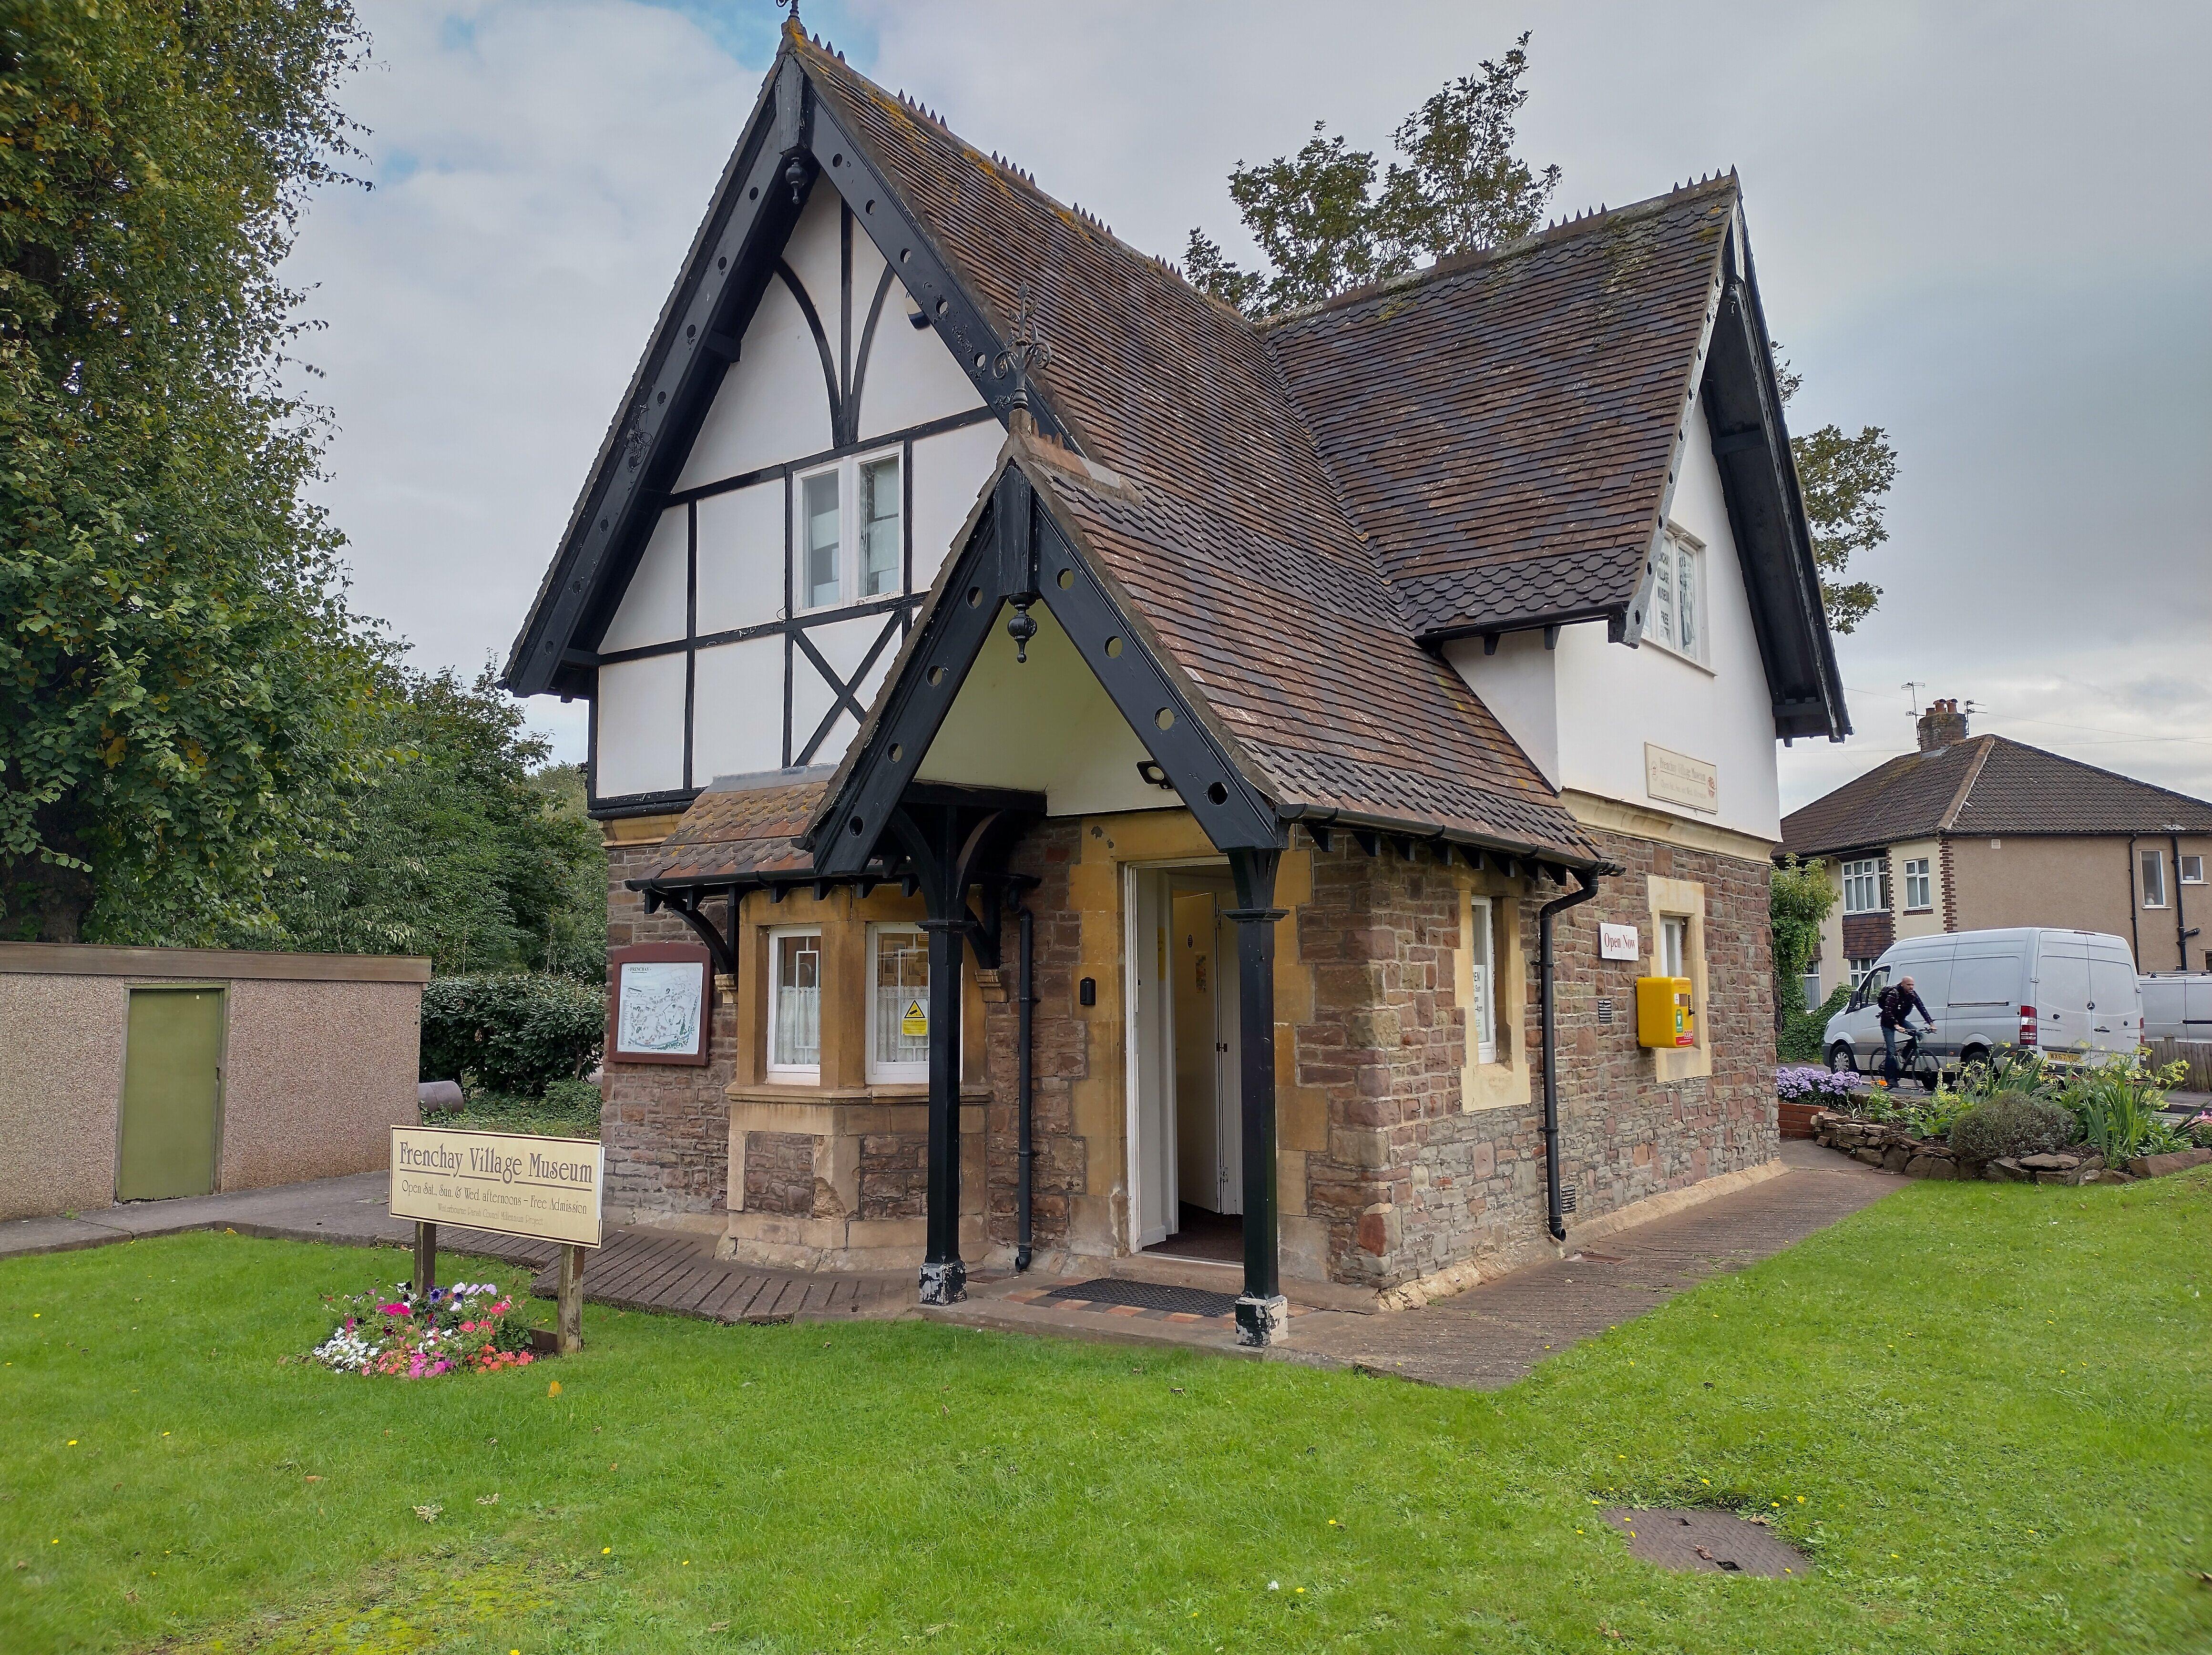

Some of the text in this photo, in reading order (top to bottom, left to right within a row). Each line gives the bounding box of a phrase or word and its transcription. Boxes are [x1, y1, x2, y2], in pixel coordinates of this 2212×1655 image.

[1605, 932, 1636, 951] Open Now
[399, 1141, 593, 1184] Frenchay Village Museum
[402, 1180, 421, 1196] Open
[439, 1185, 453, 1197] Sun.
[455, 1186, 462, 1198] &
[482, 1189, 521, 1205] afternoons
[531, 1195, 547, 1209] Free
[549, 1197, 587, 1214] Admission
[438, 1203, 543, 1226] Winterbourne Parish Council Millennium Project
